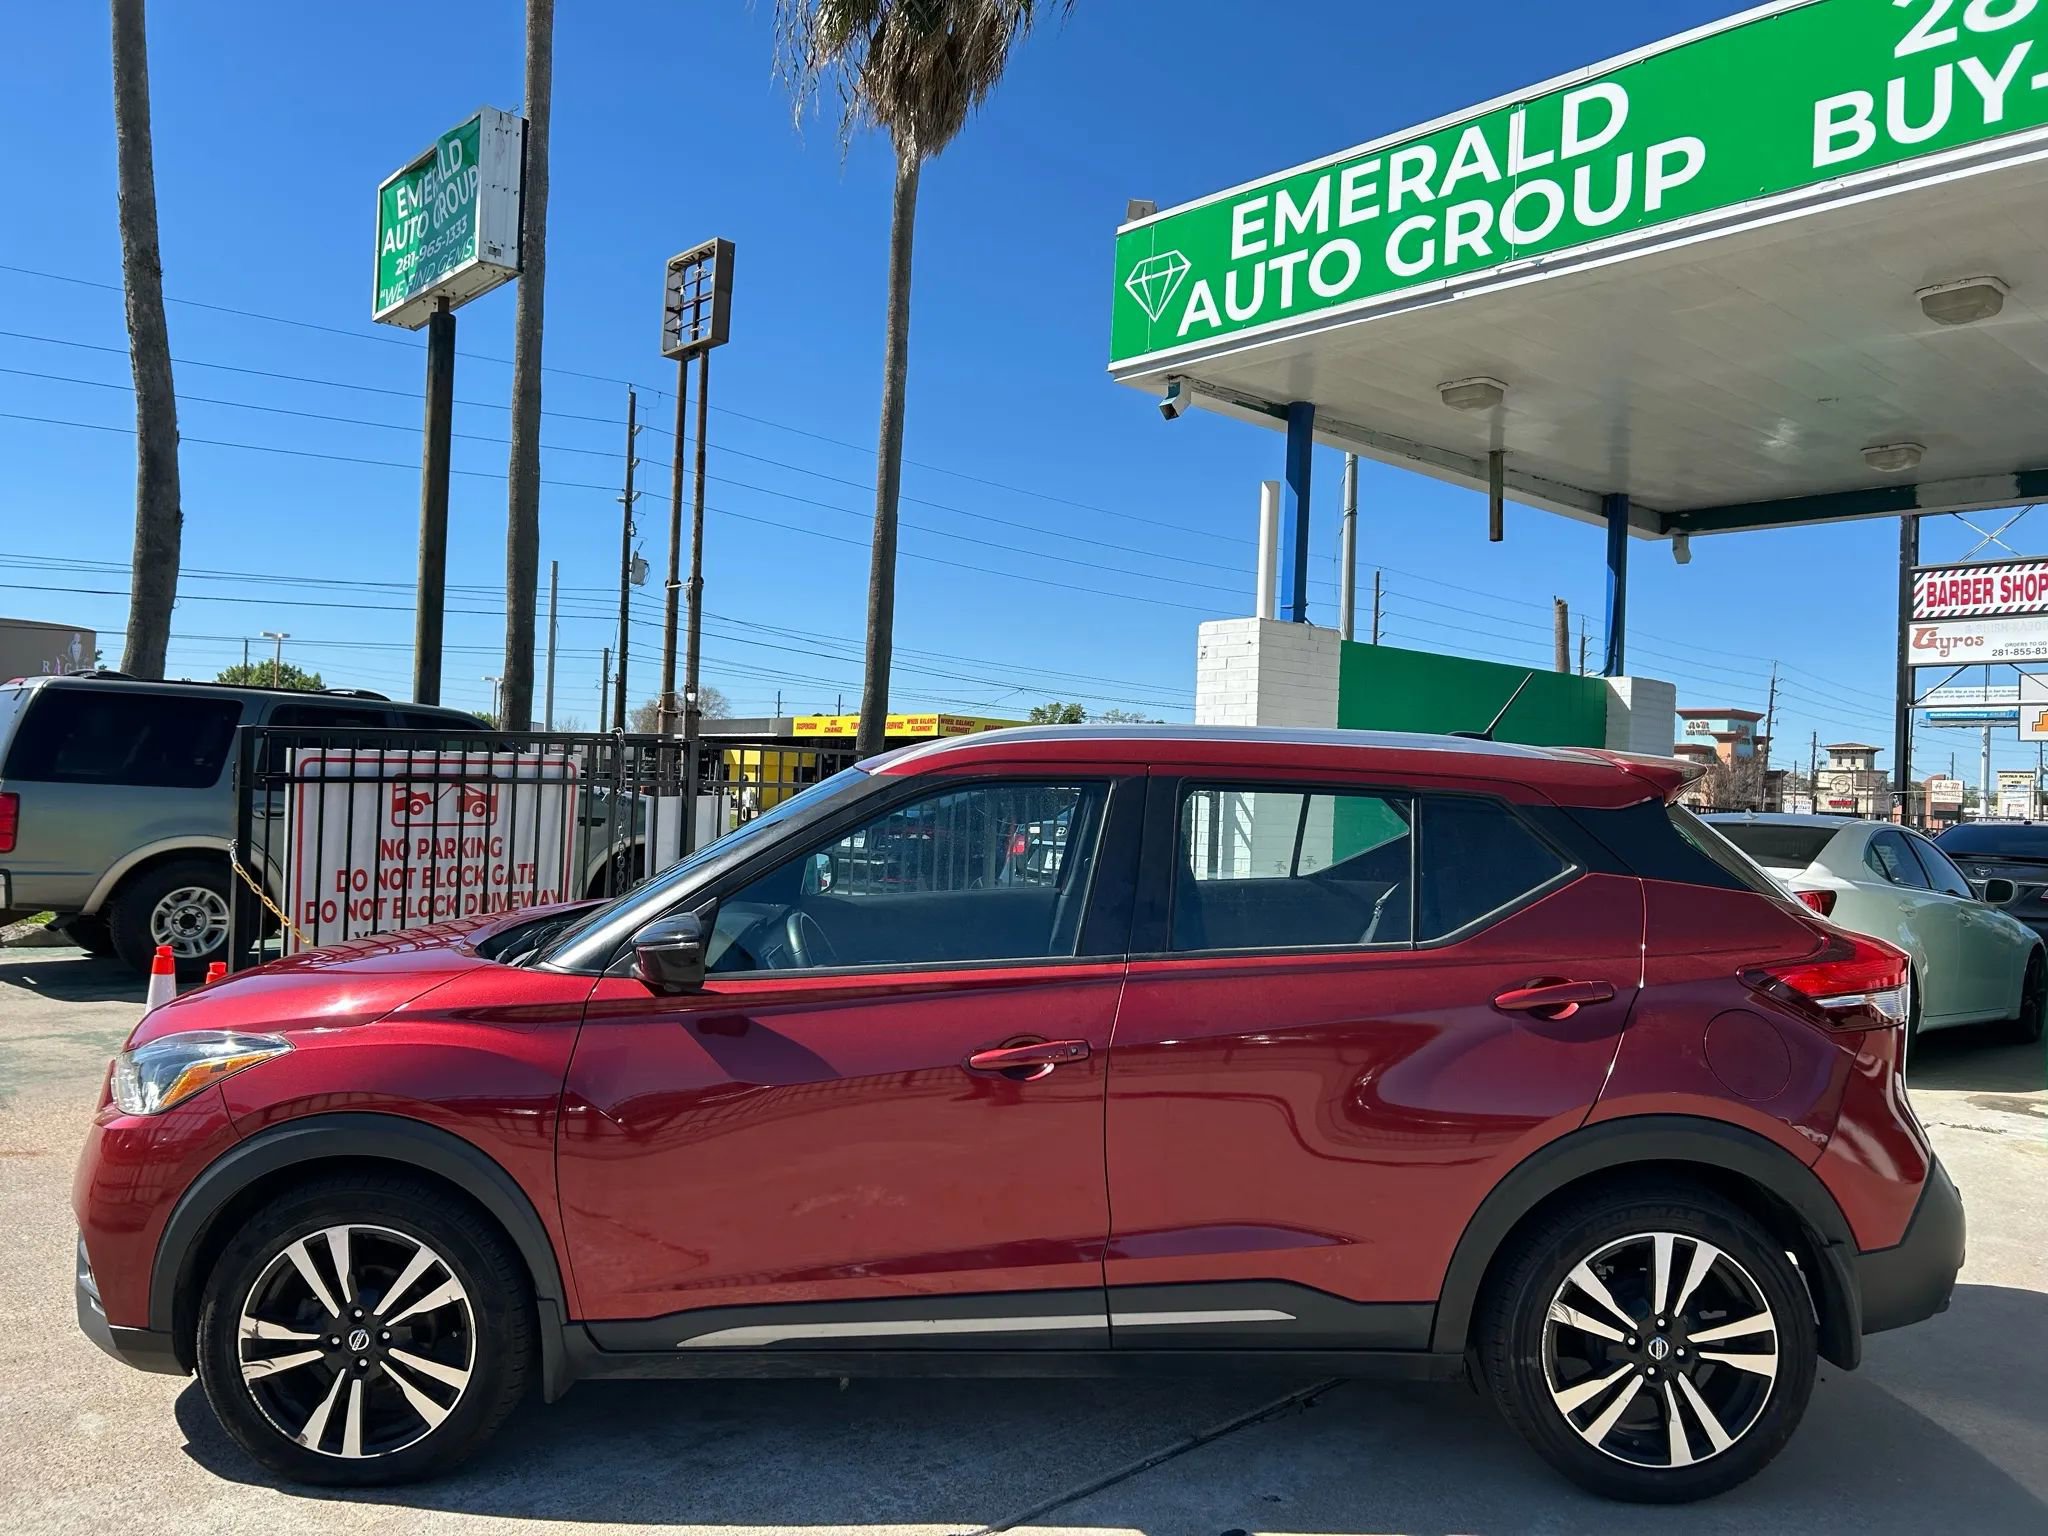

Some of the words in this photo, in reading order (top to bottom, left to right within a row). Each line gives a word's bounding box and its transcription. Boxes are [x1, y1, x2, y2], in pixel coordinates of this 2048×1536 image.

[1231, 82, 1629, 260] EMERALD
[382, 210, 429, 257] AUTO
[433, 164, 479, 229] GROUP
[395, 214, 468, 276] 281-965-1333
[1176, 238, 1362, 337] AUTO
[1385, 136, 1706, 277] GROUP
[405, 262, 436, 296] FIND
[1926, 577, 1994, 608] BARBER
[2000, 573, 2048, 603] SHOP
[1912, 627, 1984, 658] Gyros
[1992, 647, 2048, 657] 281-855-83
[381, 838, 411, 861] NO
[417, 836, 503, 860] PARKING
[336, 868, 368, 893] DO
[377, 867, 417, 890] NOT
[422, 864, 485, 889] BLOCK
[491, 863, 536, 886] GATE
[305, 899, 337, 925] DO
[346, 897, 387, 921] NOT
[392, 894, 457, 920] BLOCK
[464, 888, 560, 915] DRIVEWAY
